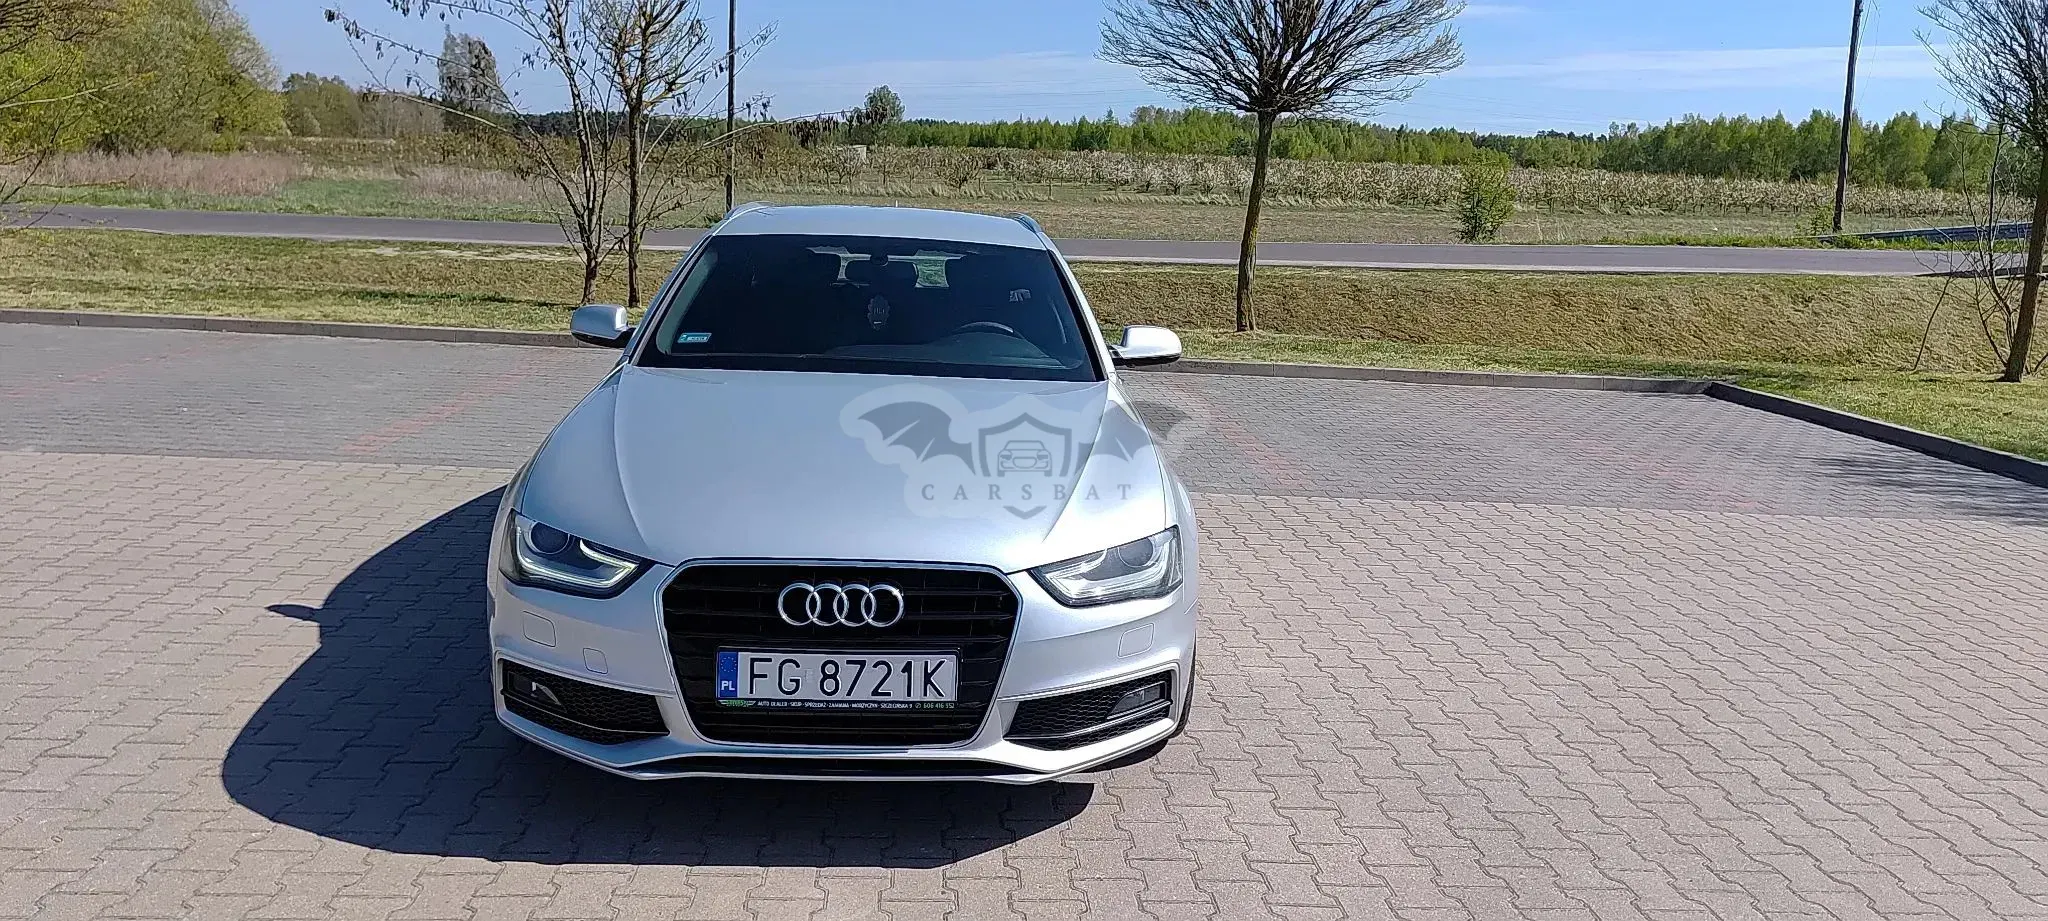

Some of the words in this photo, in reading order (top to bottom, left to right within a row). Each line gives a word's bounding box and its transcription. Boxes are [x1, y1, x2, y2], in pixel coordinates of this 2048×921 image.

[720, 680, 736, 691] PL
[748, 657, 802, 696] FG
[819, 658, 947, 698] 8721K
